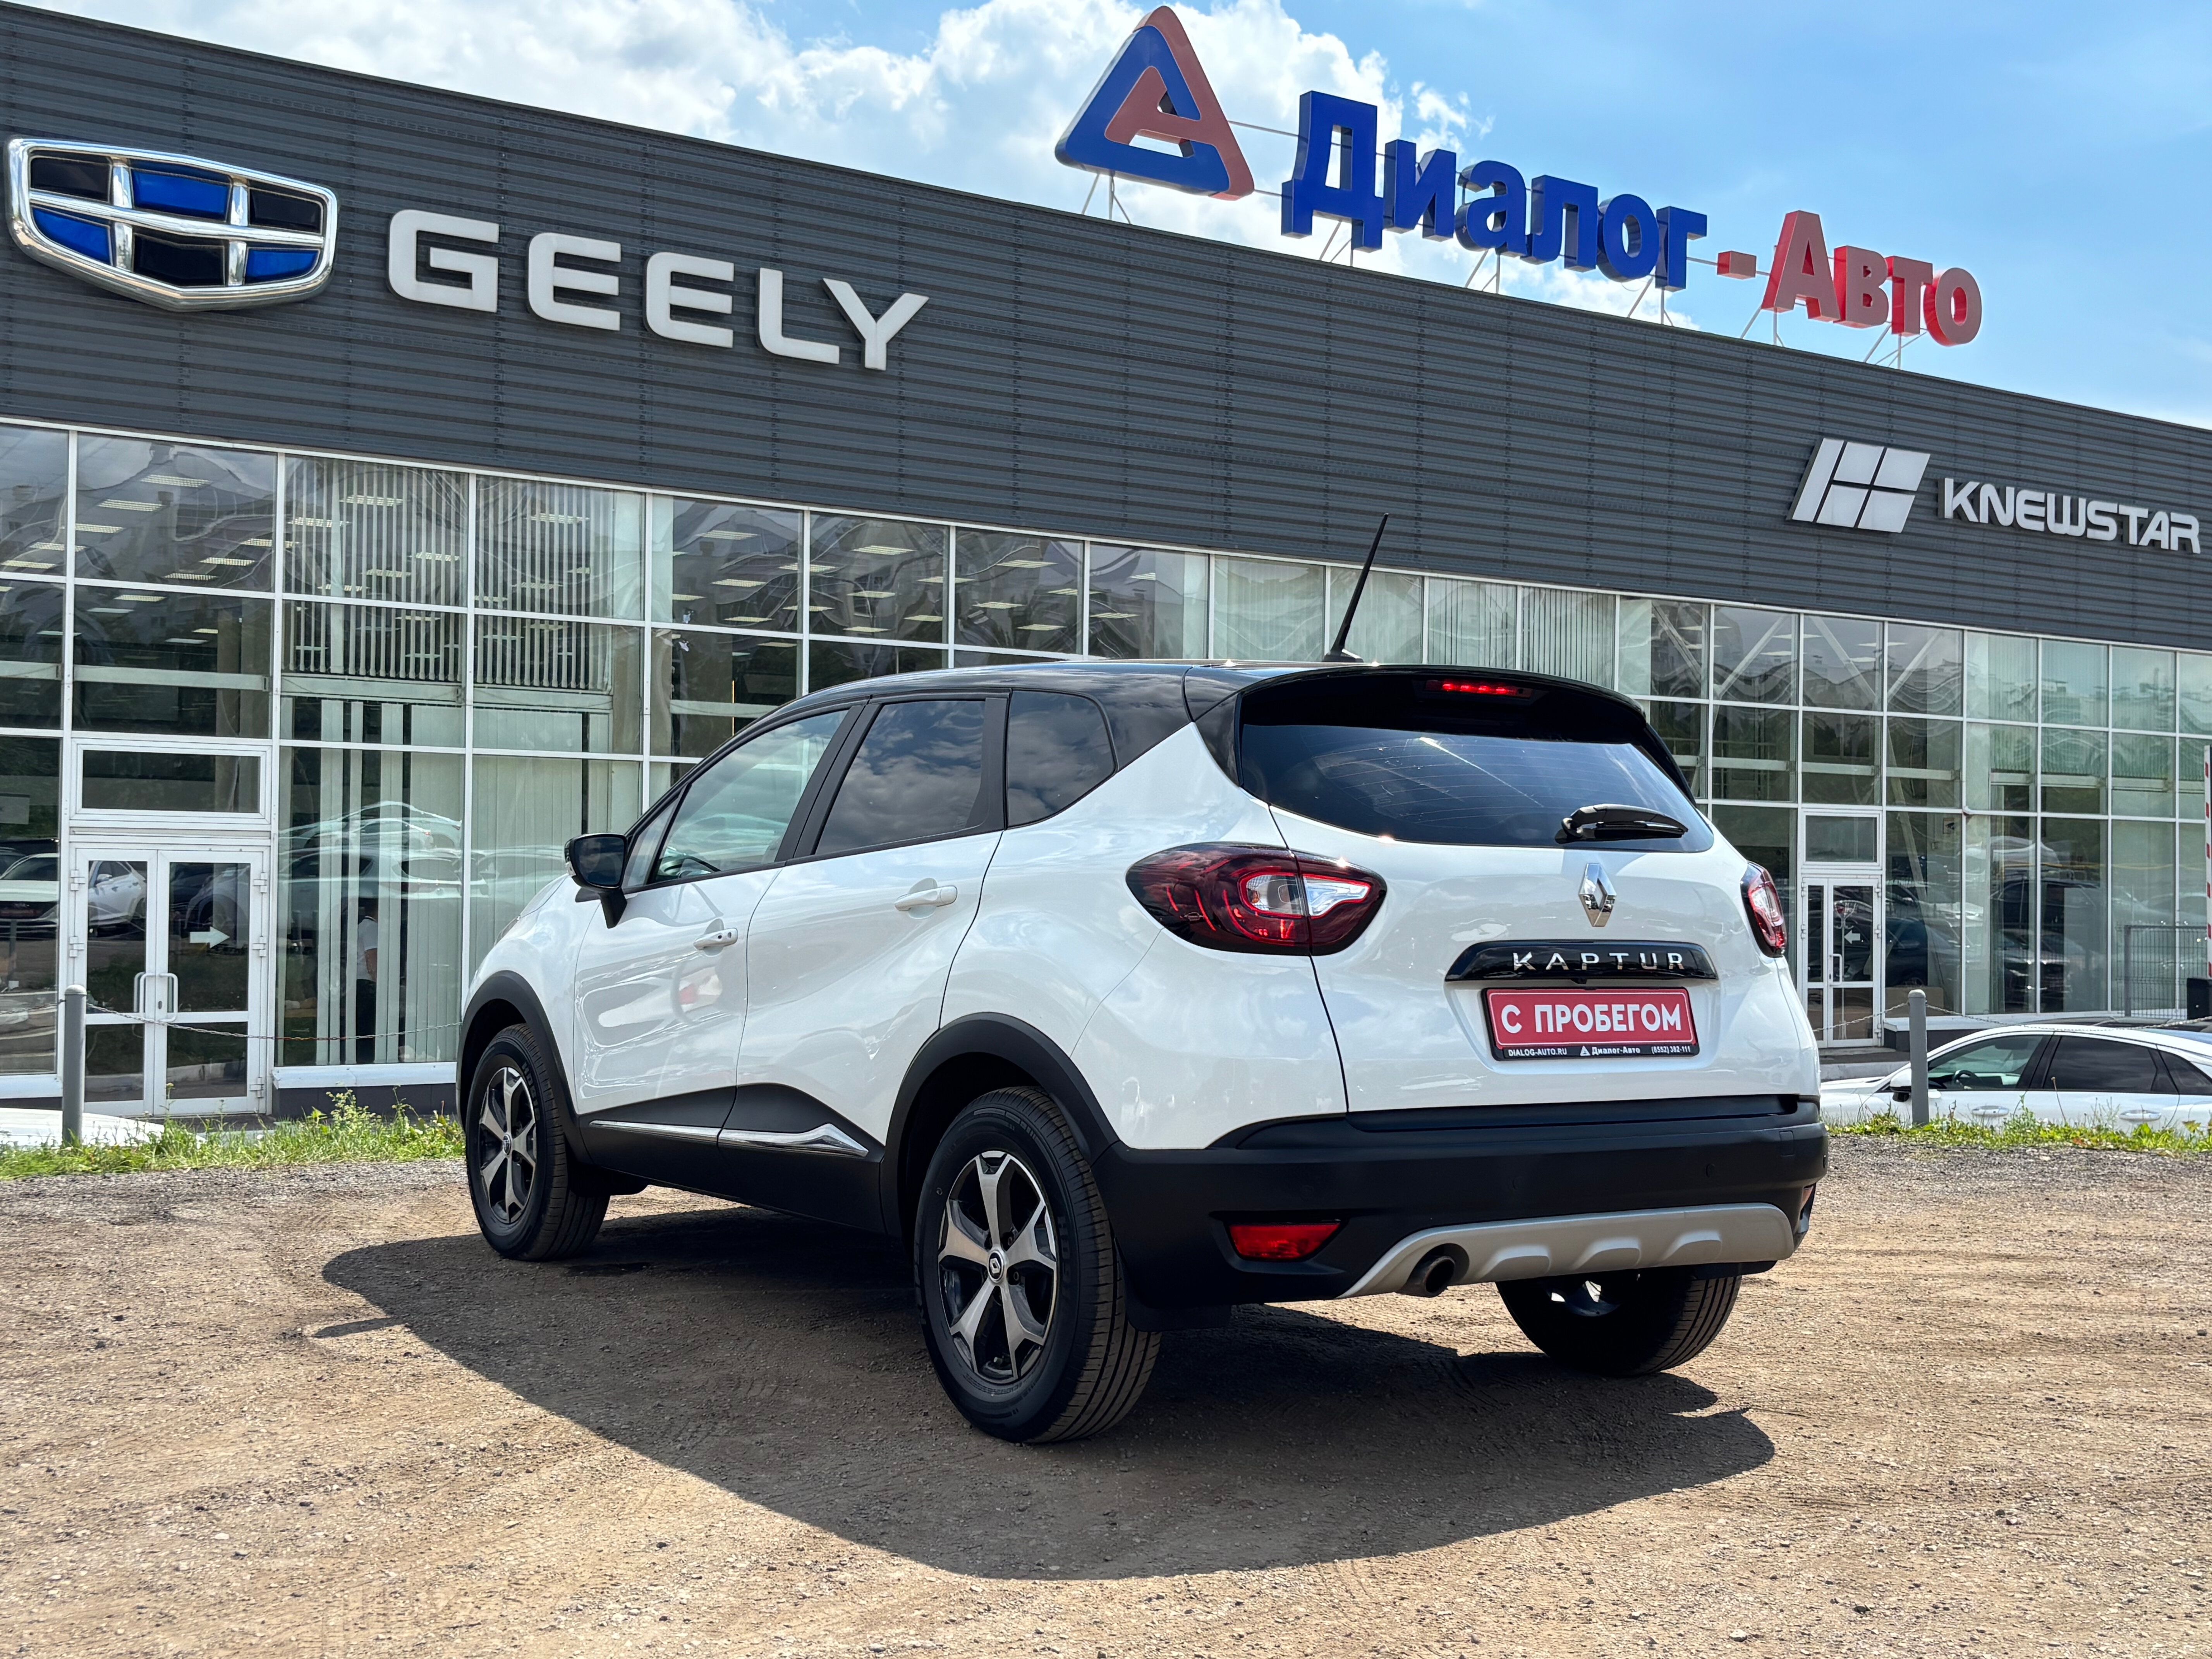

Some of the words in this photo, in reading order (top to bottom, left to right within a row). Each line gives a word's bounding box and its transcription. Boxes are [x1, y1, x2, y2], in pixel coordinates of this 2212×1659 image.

[388, 208, 929, 372] GEELY
[1940, 477, 2201, 554] KNEWSTAR
[1513, 951, 1684, 970] KAPTUR
[1501, 1004, 1521, 1034] С
[1535, 1003, 1681, 1032] ПРОБЕГОМ
[1508, 1048, 1567, 1056] DIALOG-AUTO.RU
[1592, 1046, 1641, 1055] Диалог-Авто
